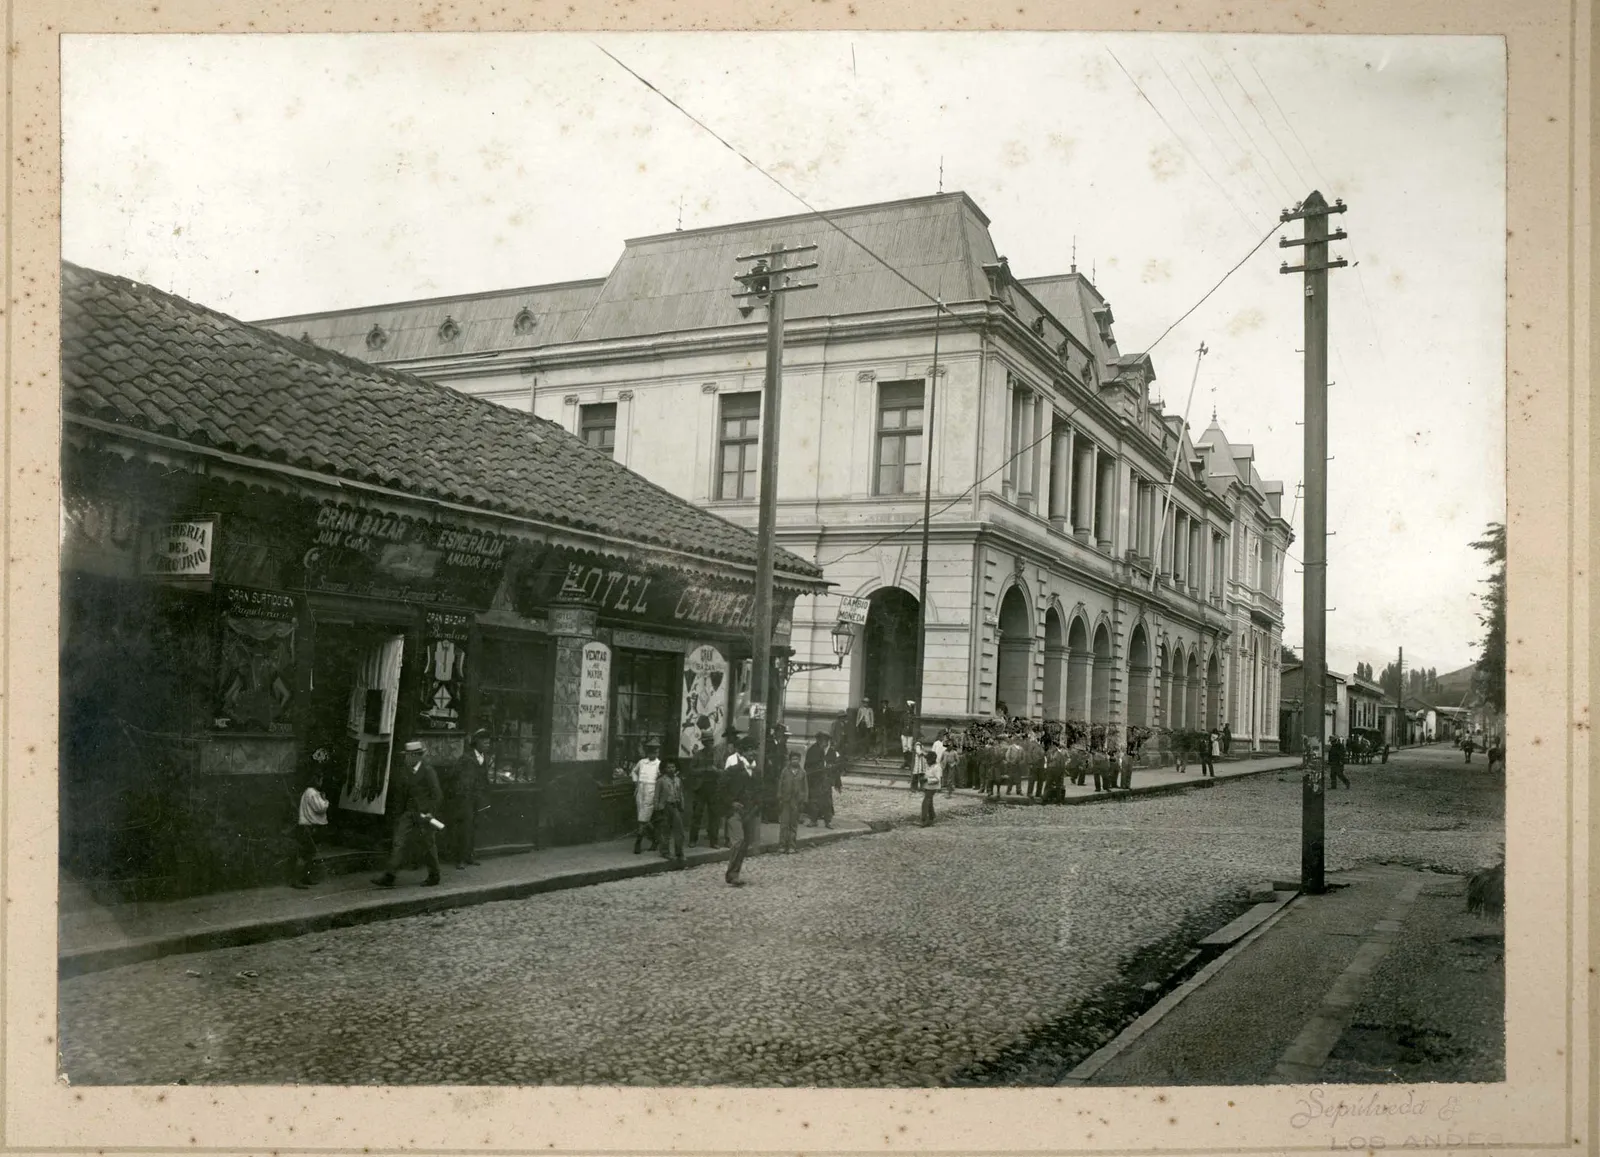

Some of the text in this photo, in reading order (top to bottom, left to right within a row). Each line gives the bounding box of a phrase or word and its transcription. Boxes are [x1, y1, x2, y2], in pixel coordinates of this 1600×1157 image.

[317, 507, 407, 540] GRAN BAZAR
[168, 542, 189, 553] DEL
[437, 529, 505, 559] ESMERALDA
[558, 561, 757, 628] HOTEL CENTRA
[843, 597, 868, 609] CAMBIO
[585, 649, 607, 662] VENTAS
[1330, 1134, 1387, 1150] LOS
